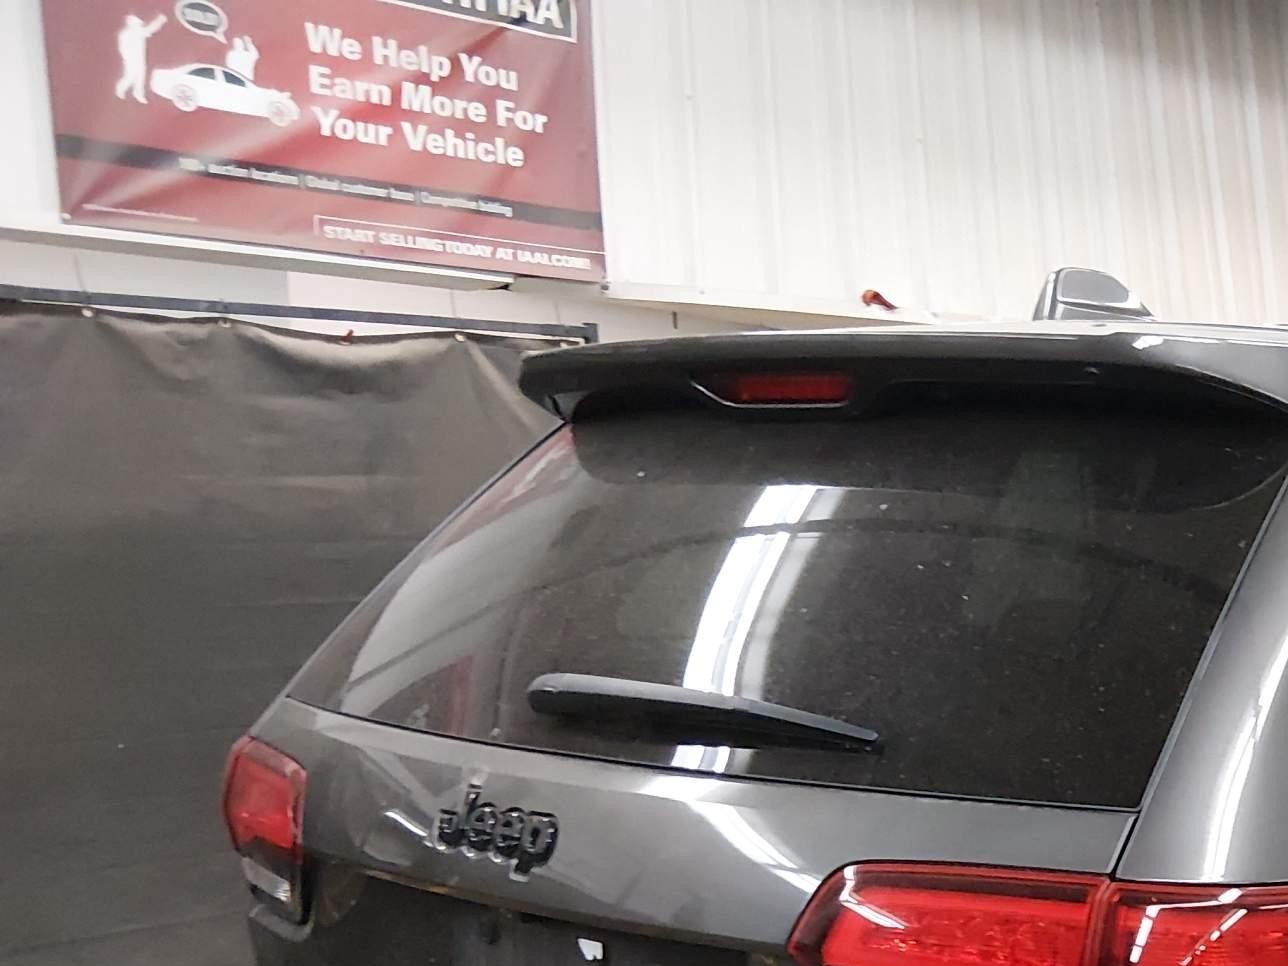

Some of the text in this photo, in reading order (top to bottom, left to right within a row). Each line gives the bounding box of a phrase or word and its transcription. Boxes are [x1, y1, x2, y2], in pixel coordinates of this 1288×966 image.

[304, 22, 519, 91] We Help You
[308, 65, 548, 133] Earn More For
[310, 105, 525, 167] Your Vehicle
[322, 225, 375, 243] START
[379, 232, 443, 252] SELLING
[443, 241, 494, 258] TODAY
[495, 247, 515, 260] AT
[438, 783, 559, 874] Jeep
